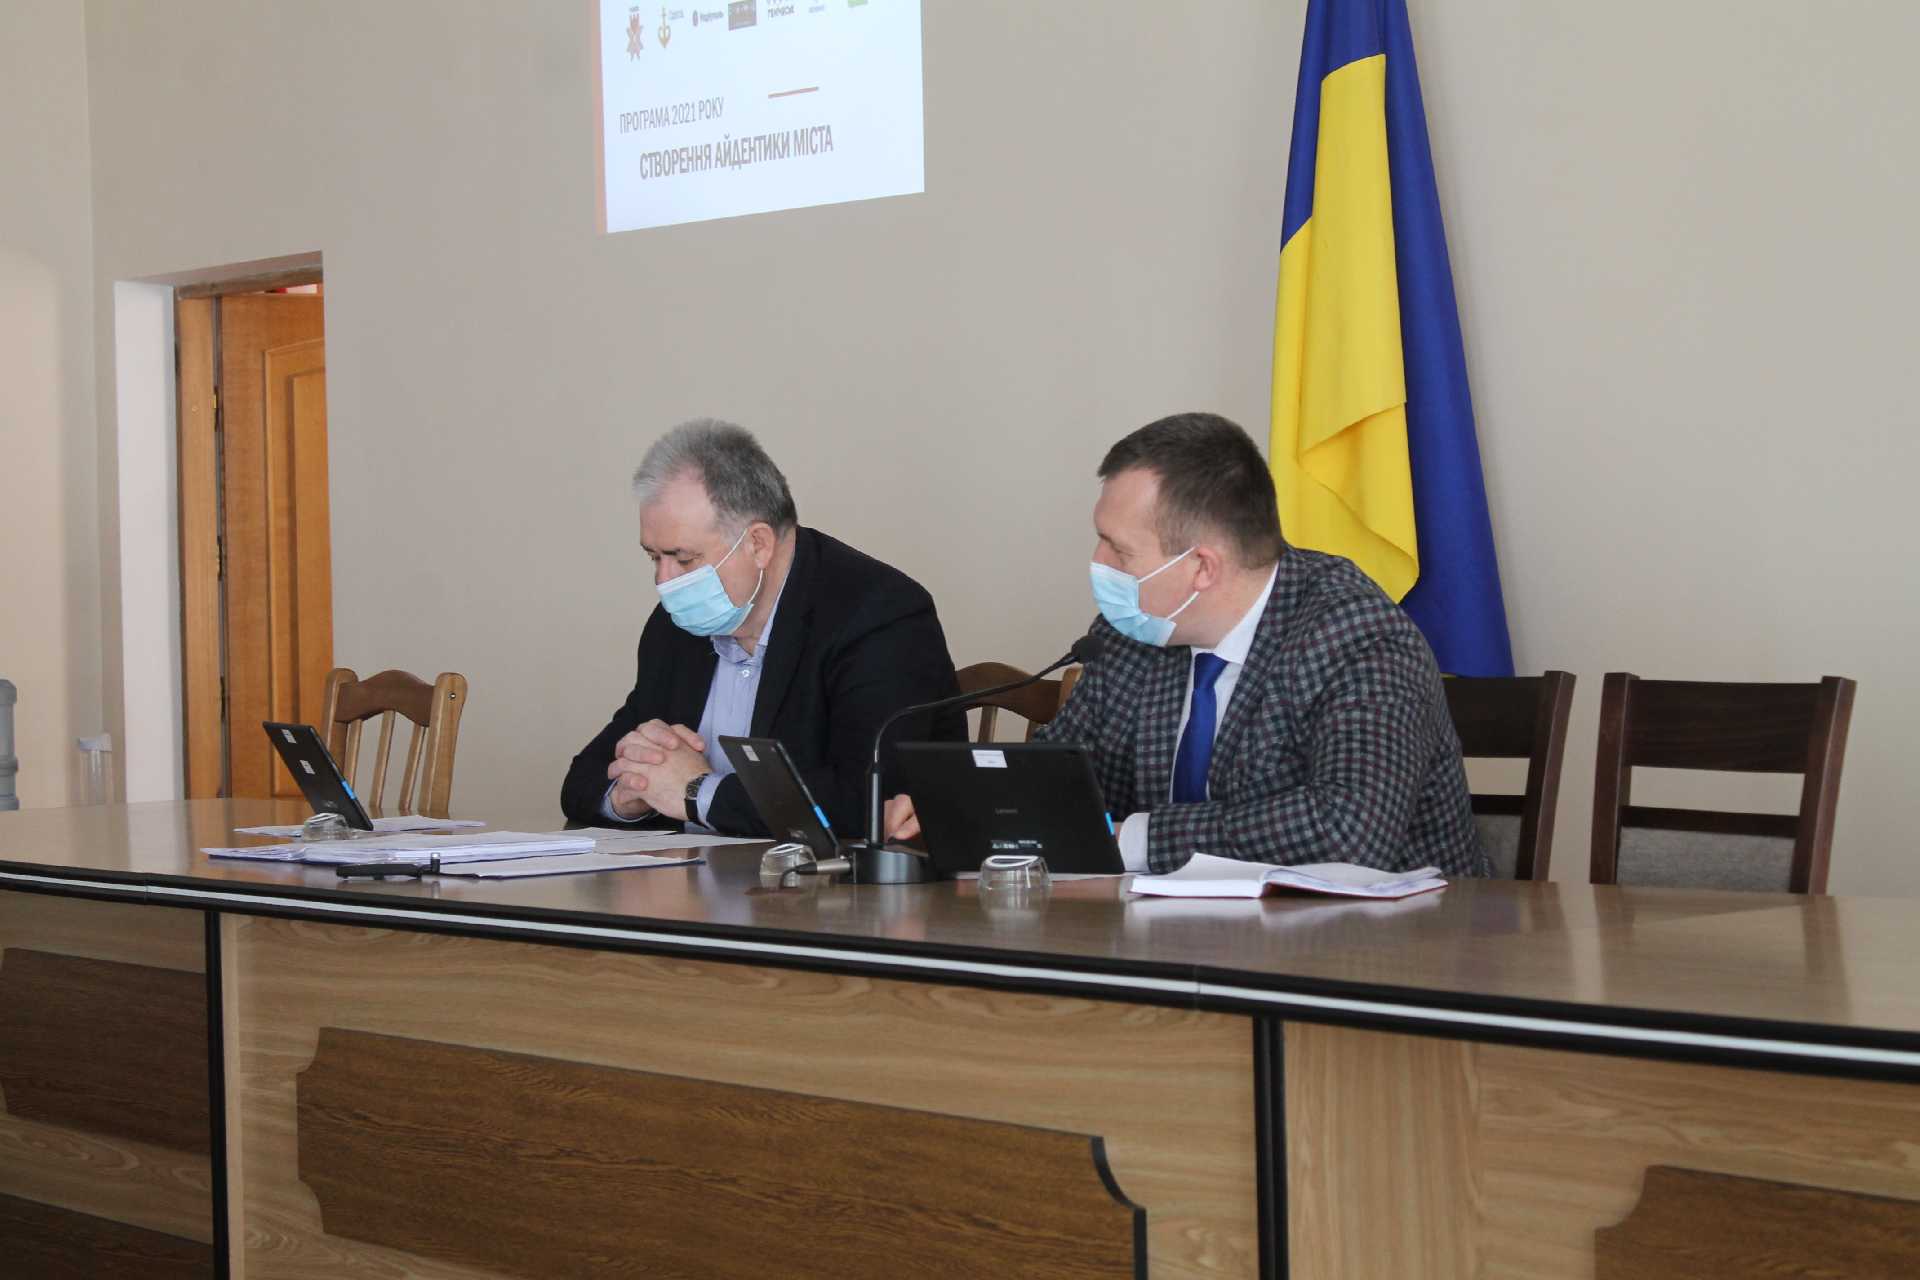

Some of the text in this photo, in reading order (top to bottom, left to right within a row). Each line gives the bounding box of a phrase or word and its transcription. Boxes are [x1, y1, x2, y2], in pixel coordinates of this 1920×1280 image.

[620, 97, 724, 134] ПРОГРАМА 2021 РОКУ
[640, 126, 834, 180] СТВОРЕННЯ АЙДЕНТИКИ МІСТА
